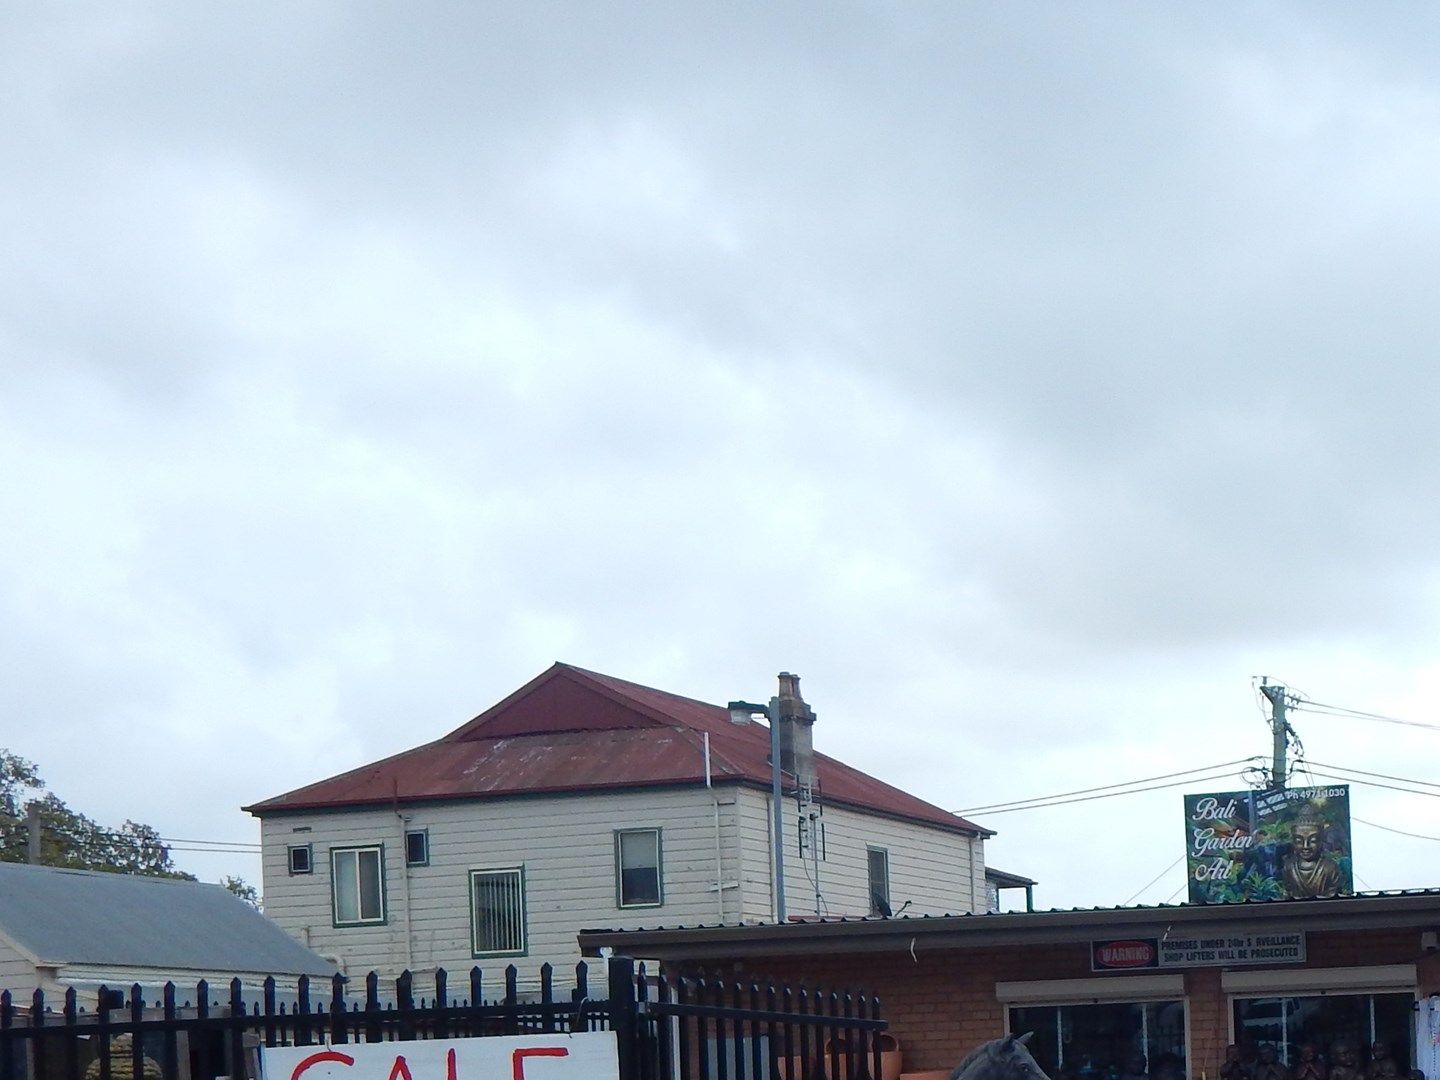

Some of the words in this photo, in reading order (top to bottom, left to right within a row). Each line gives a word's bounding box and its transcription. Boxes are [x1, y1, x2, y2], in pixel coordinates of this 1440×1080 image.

[1324, 788, 1346, 798] 1030
[1192, 797, 1238, 821] Bali
[1191, 828, 1253, 857] Garden
[1195, 857, 1234, 880] Art
[1200, 939, 1225, 949] UNDER
[1102, 946, 1150, 962] WARNING
[1164, 952, 1184, 962] SHOP
[1186, 950, 1216, 961] LIFTERS
[1218, 949, 1235, 959] WILL
[1237, 949, 1248, 959] BE
[1250, 947, 1298, 959] PROSECUTED
